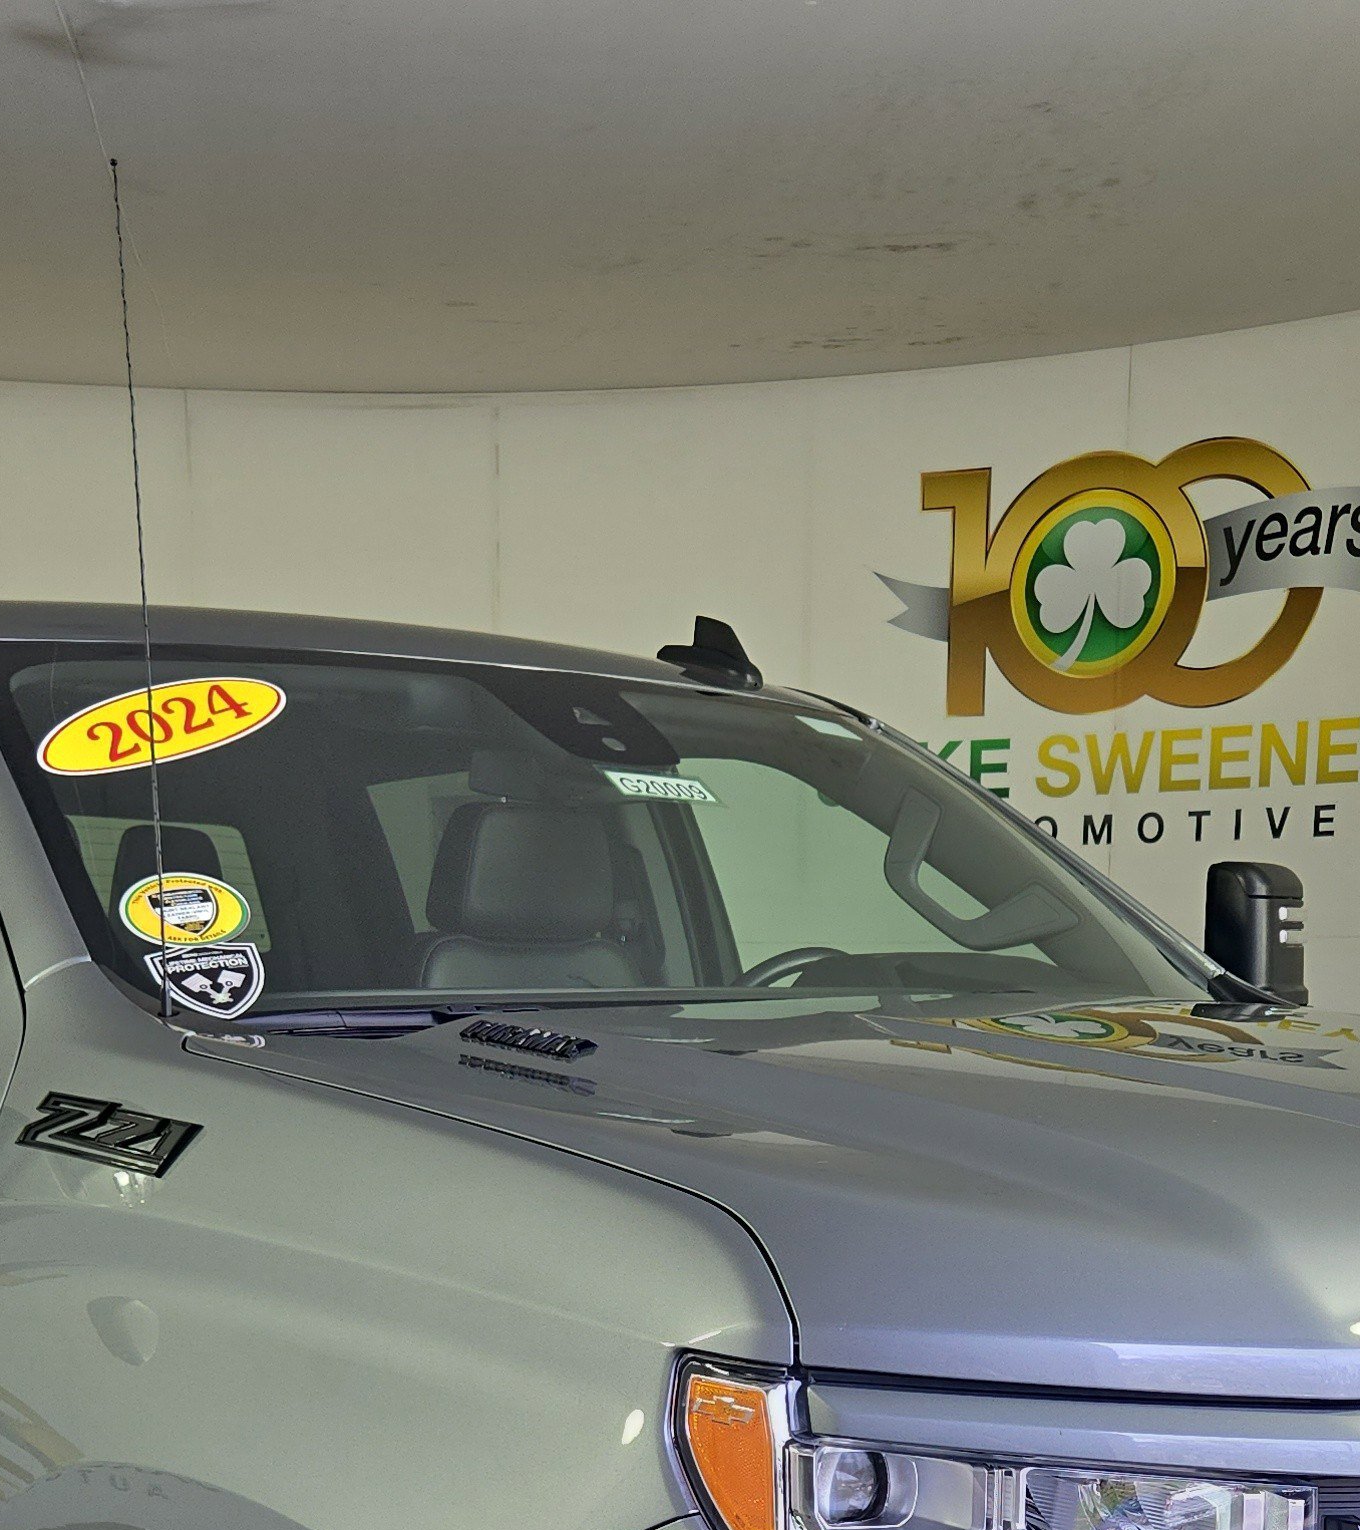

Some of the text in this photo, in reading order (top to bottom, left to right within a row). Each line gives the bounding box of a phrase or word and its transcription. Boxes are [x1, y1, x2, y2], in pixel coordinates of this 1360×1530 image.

[920, 436, 1325, 717] 100
[86, 684, 253, 762] 2024
[620, 777, 708, 800] G20009
[1034, 804, 1338, 846] OMOTIVE
[166, 957, 249, 975] PROTECTION
[15, 1091, 205, 1178] Z71
